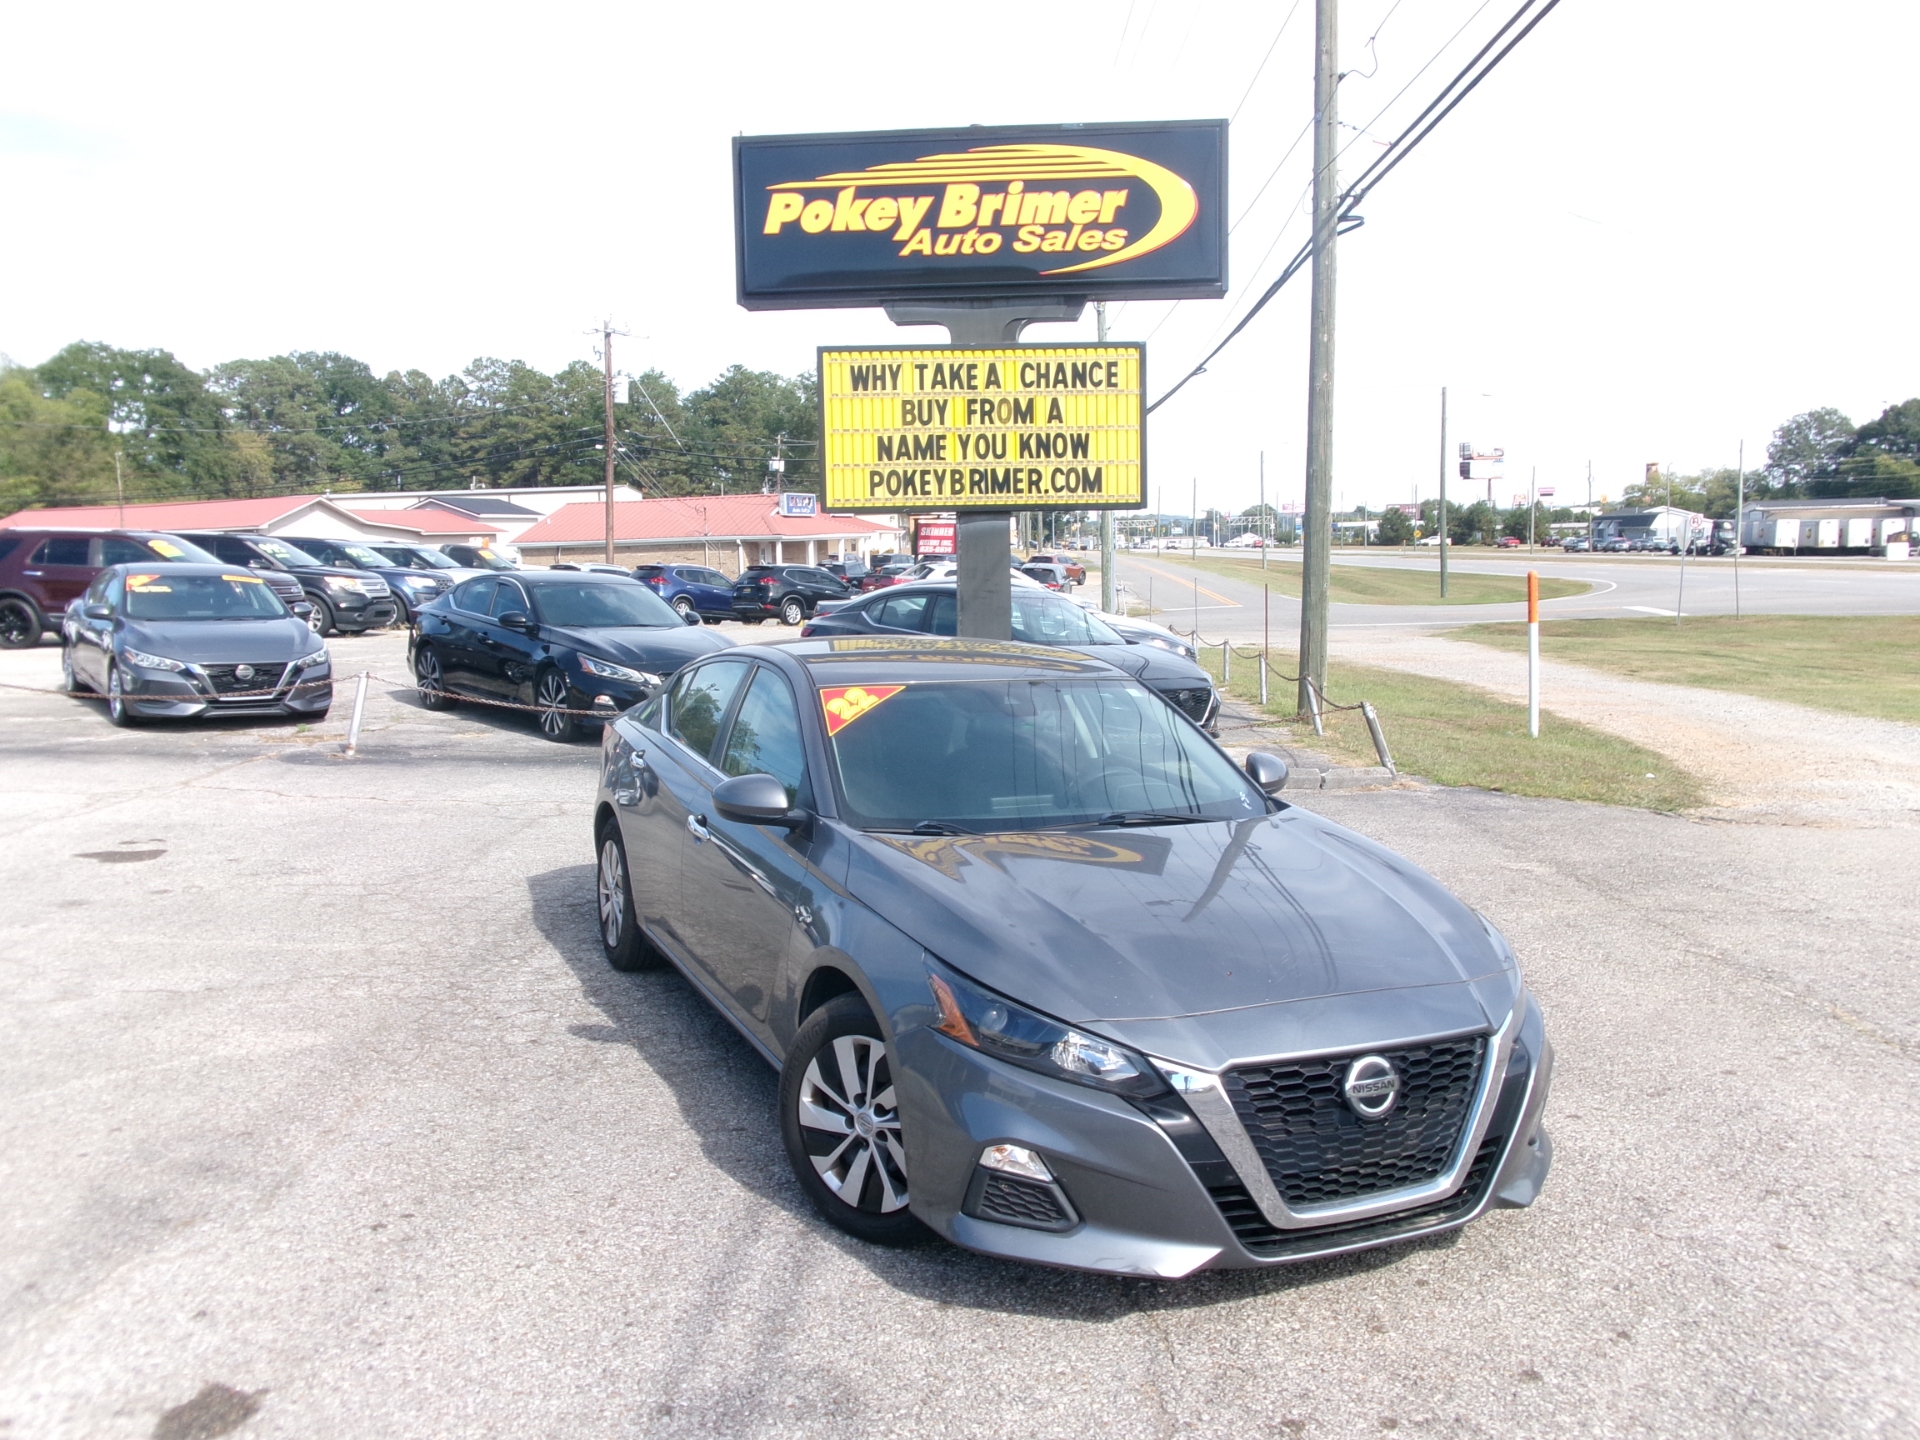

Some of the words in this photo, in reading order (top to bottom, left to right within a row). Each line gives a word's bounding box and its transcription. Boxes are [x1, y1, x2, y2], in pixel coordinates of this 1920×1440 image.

[763, 186, 935, 241] Pokey
[937, 180, 1129, 228] Brimer
[898, 227, 1002, 257] Auto
[1012, 224, 1129, 253] Sales
[850, 363, 902, 392] WHY
[914, 362, 979, 391] TAKE
[984, 362, 1002, 390] A
[1020, 361, 1119, 389] CHANCE
[901, 398, 949, 427] BUY
[966, 397, 1035, 426] FROM
[1046, 397, 1064, 424] A
[877, 433, 948, 462] NAME
[957, 433, 1007, 460] YOU
[1019, 432, 1090, 460] KNOW
[869, 466, 1103, 497] POKEYBRIMER.COM
[920, 526, 954, 537] SKINNER
[826, 687, 880, 721] 22
[1352, 1079, 1396, 1094] NISSAN
